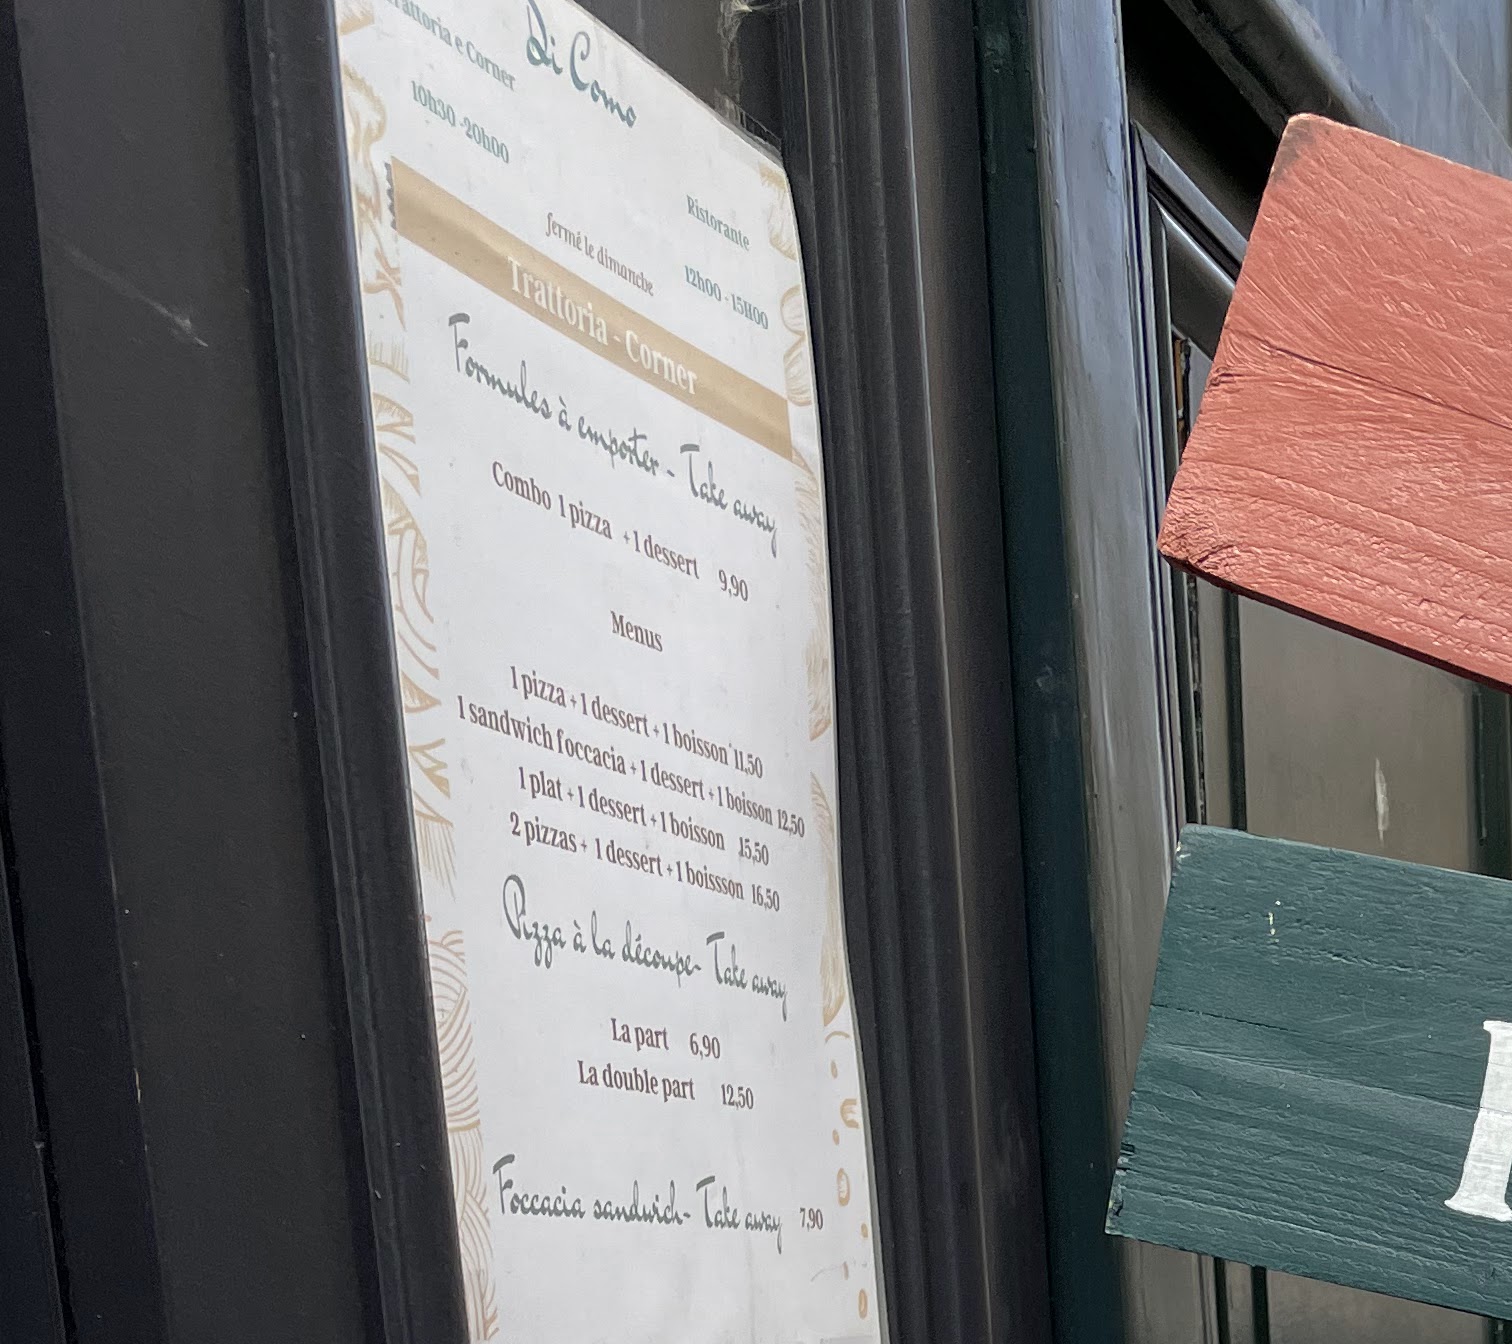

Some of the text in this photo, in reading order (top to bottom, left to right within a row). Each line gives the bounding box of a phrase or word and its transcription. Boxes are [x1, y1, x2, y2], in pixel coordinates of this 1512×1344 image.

[387, 0, 516, 91] attoria e Corner
[526, 0, 637, 128] Di Como
[411, 80, 456, 127] 10h30
[545, 212, 654, 296] fermé le dimanche
[686, 194, 750, 251] Ristorante
[507, 256, 609, 346] Trattoria
[625, 329, 698, 395] Corner
[685, 265, 722, 302] 12h00
[731, 293, 769, 330] 15H00
[448, 312, 552, 419] Formules
[558, 395, 571, 431] à
[578, 413, 660, 475] emporter
[680, 443, 728, 510] Take
[733, 499, 778, 558] away
[492, 460, 552, 510] Combo
[569, 501, 613, 540] pizza
[644, 534, 700, 580] dessert
[718, 569, 749, 601] 9,90
[610, 610, 663, 652] Menus
[521, 670, 567, 708] pizza
[591, 695, 650, 738] dessert
[672, 723, 729, 766] boisson
[469, 702, 554, 751] sandwich
[556, 728, 627, 776] foccacia
[650, 762, 705, 801] dessert
[725, 786, 773, 826] boisson
[777, 808, 805, 838] 12,50
[529, 770, 563, 801] plat
[588, 788, 647, 827] dessert
[669, 811, 725, 850] boisson
[738, 837, 769, 866] 15,50
[510, 811, 521, 837] 2
[524, 816, 577, 853] pizzas
[606, 839, 664, 877] dessert
[751, 883, 780, 912] 16,50
[502, 874, 567, 969] Pizza
[573, 919, 587, 953] à
[591, 910, 616, 960] la
[706, 931, 748, 989] Take
[752, 974, 788, 1022] away
[577, 1059, 754, 1111] La double part 12,50
[610, 1017, 721, 1060] La part 6,90
[493, 1154, 586, 1219] Foccacia
[696, 1175, 740, 1229] Take
[745, 1211, 783, 1255] away
[799, 1207, 824, 1232] 7,90
